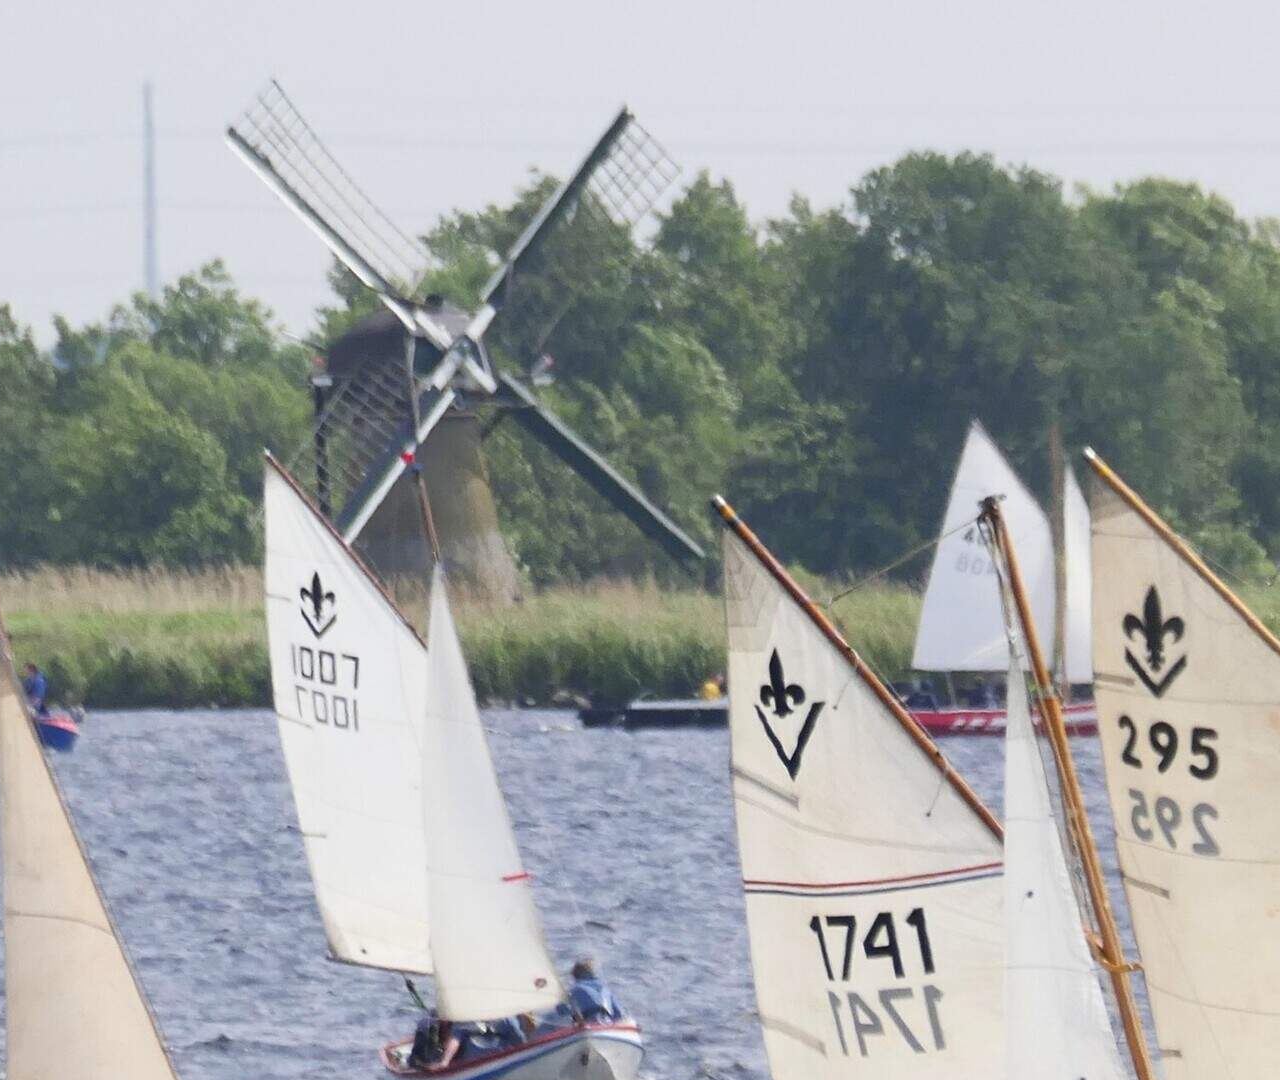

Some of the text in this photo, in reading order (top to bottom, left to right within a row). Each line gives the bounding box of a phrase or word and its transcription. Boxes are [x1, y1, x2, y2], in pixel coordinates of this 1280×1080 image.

[290, 642, 359, 690] 1007
[1118, 715, 1219, 781] 295
[809, 907, 935, 981] 1741
